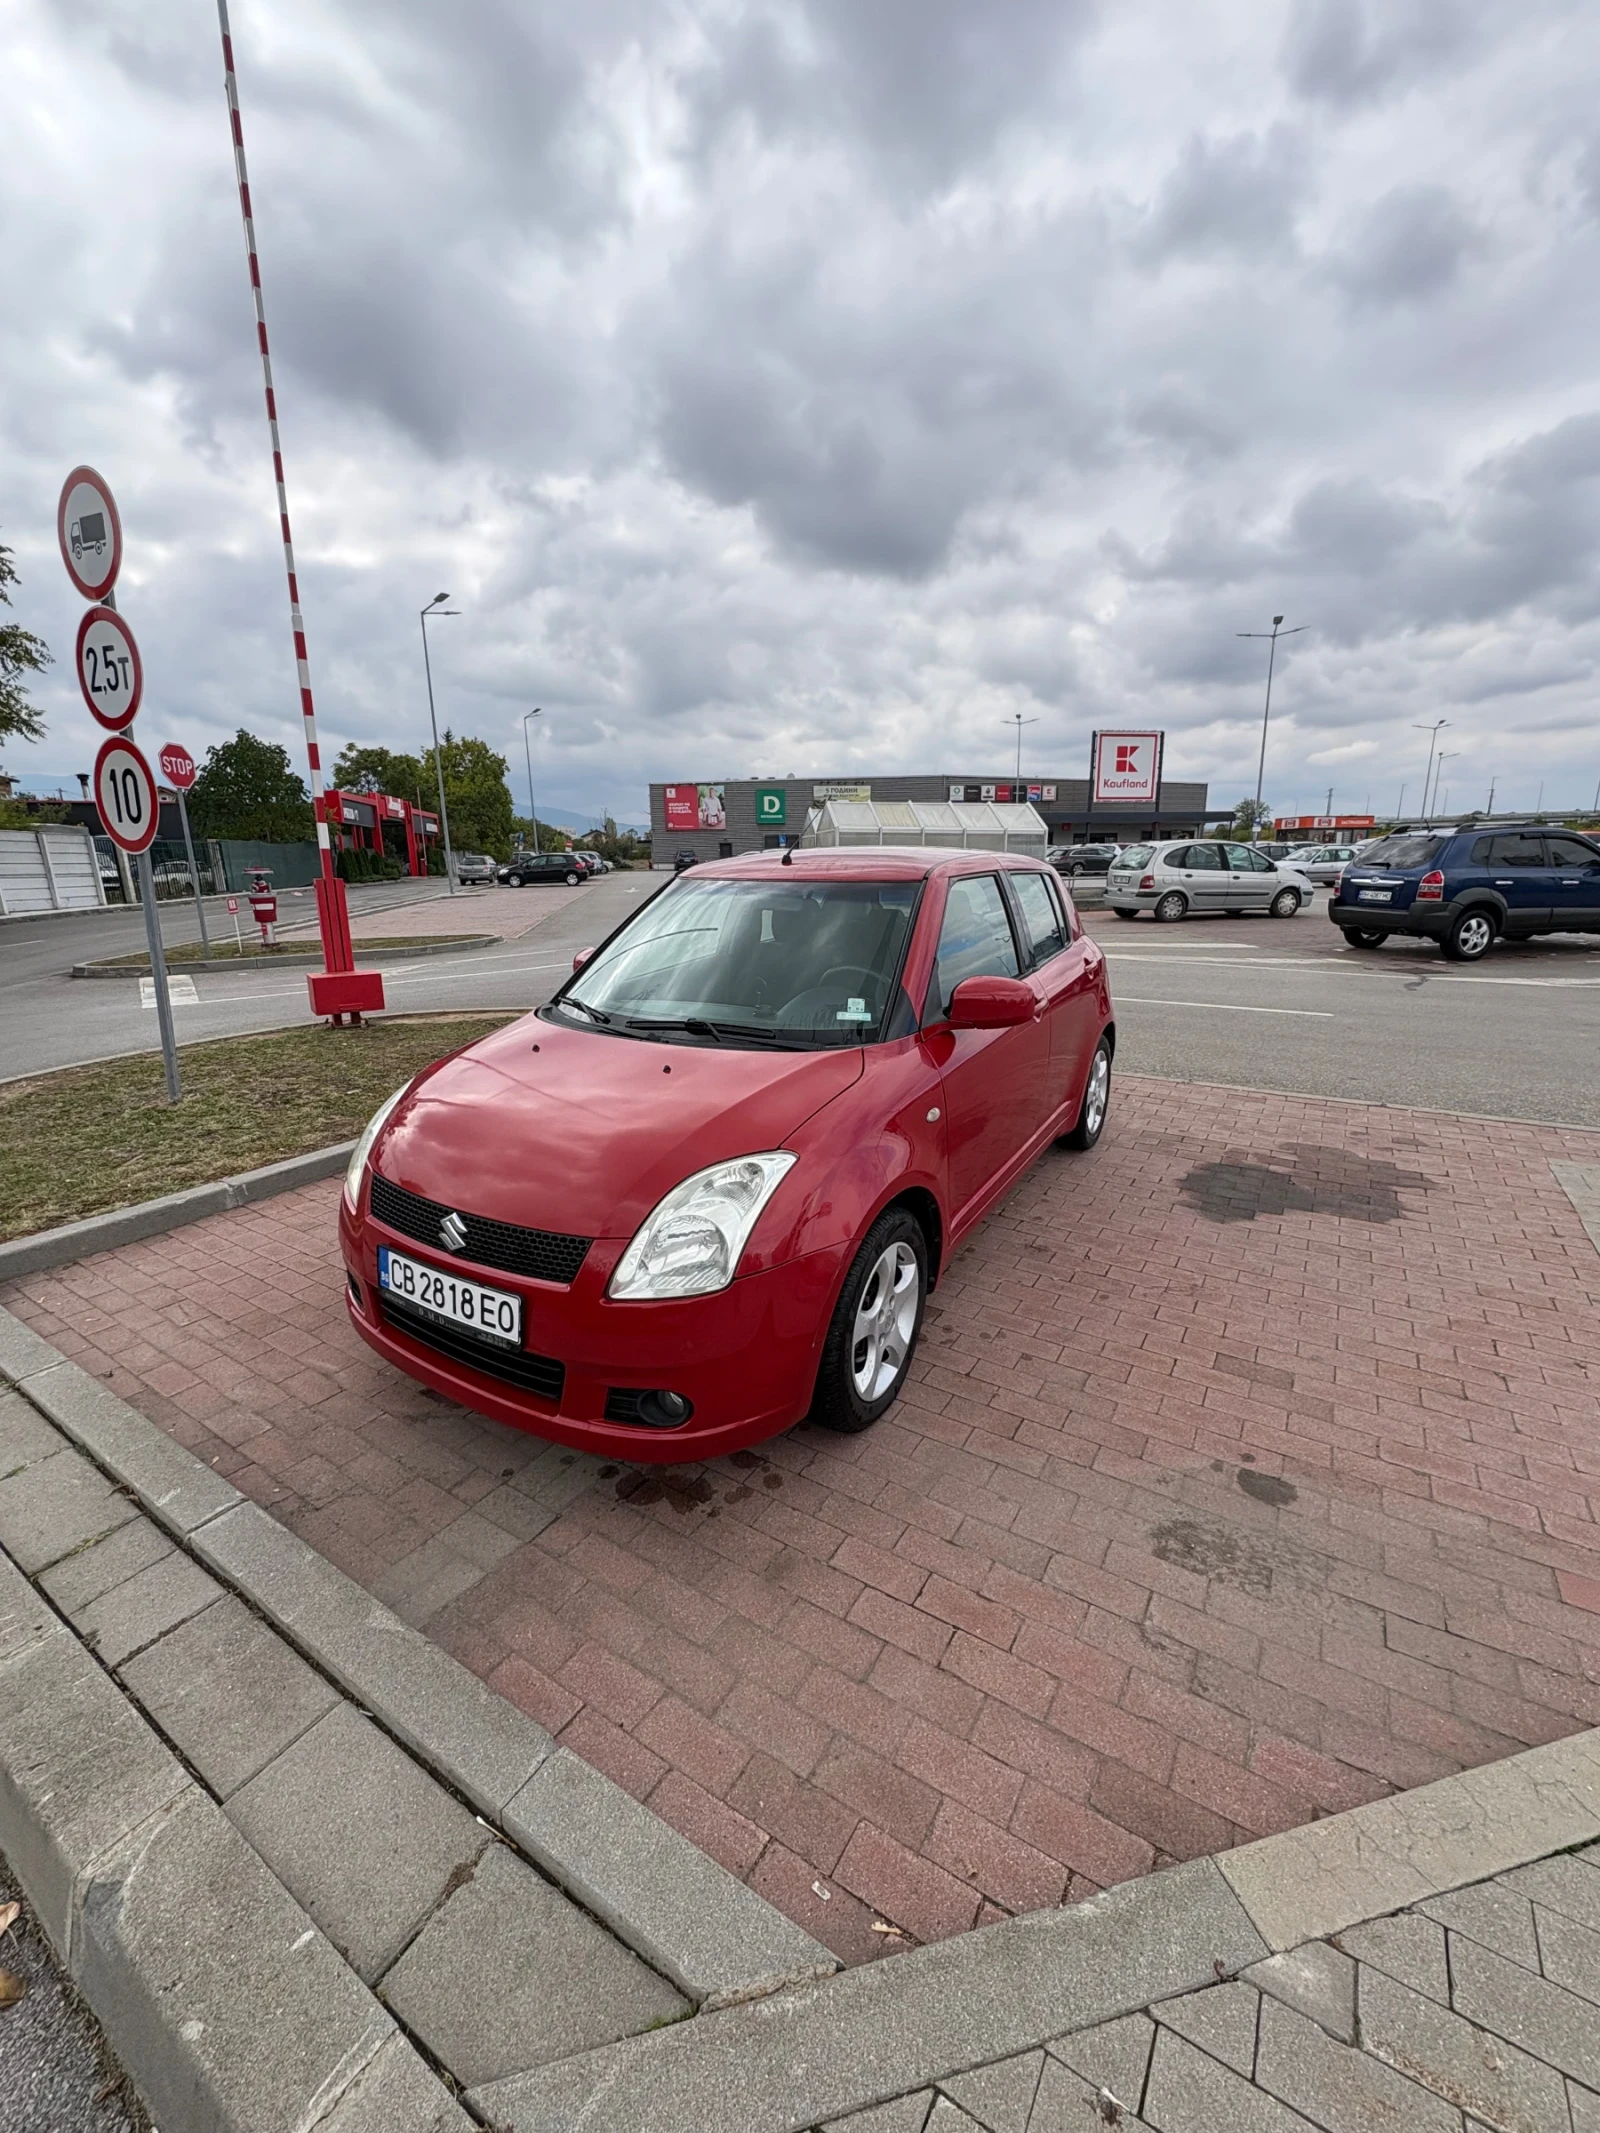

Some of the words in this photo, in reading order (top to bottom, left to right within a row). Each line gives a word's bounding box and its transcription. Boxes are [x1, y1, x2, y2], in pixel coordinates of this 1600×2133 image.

[162, 756, 193, 776] STOP
[1103, 778, 1148, 788] Kaufland
[109, 768, 142, 824] 10
